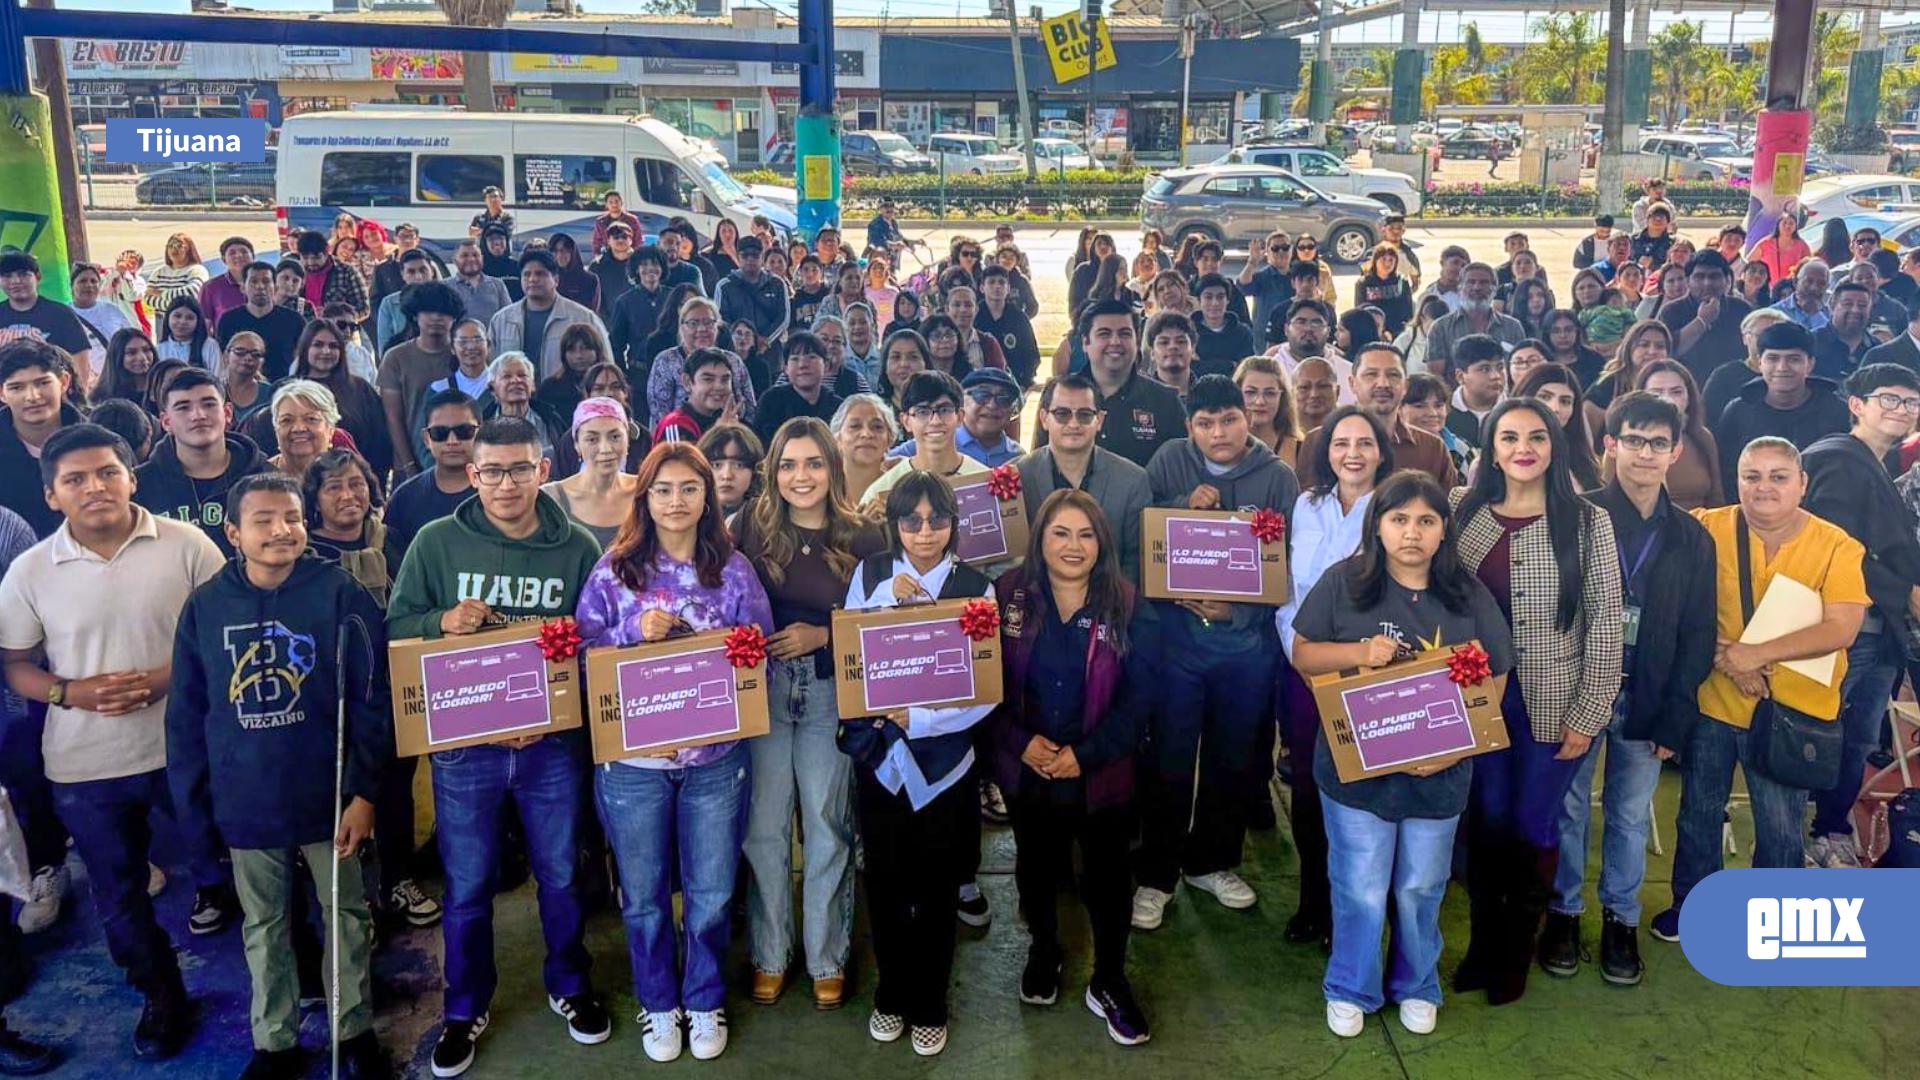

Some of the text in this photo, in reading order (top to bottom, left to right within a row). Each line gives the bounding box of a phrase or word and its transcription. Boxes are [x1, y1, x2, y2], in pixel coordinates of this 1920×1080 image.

[72, 41, 186, 62] EL BASTO
[1059, 38, 1104, 62] CLUB
[1153, 552, 1168, 565] INC
[1192, 549, 1229, 558] PUEDO
[457, 572, 564, 609] UABC
[844, 654, 856, 667] IN
[868, 655, 935, 673] ¡LO PUEDO
[845, 667, 863, 682] INC
[869, 666, 924, 680] LOGRAR!
[403, 685, 417, 700] IN
[431, 680, 506, 701] ¡LO PUEDO
[626, 687, 698, 709] ¡LO PUEDO
[404, 702, 426, 716] INC
[432, 692, 493, 710] LOGRAR!
[600, 694, 612, 707] IN
[627, 700, 685, 718] LOGRAR!
[240, 711, 305, 729] VIZCAINO
[601, 709, 621, 723] INC
[1332, 718, 1346, 732] IN
[1358, 709, 1426, 733] ¡LO PUEDO
[1360, 721, 1415, 740] LOGRAR!
